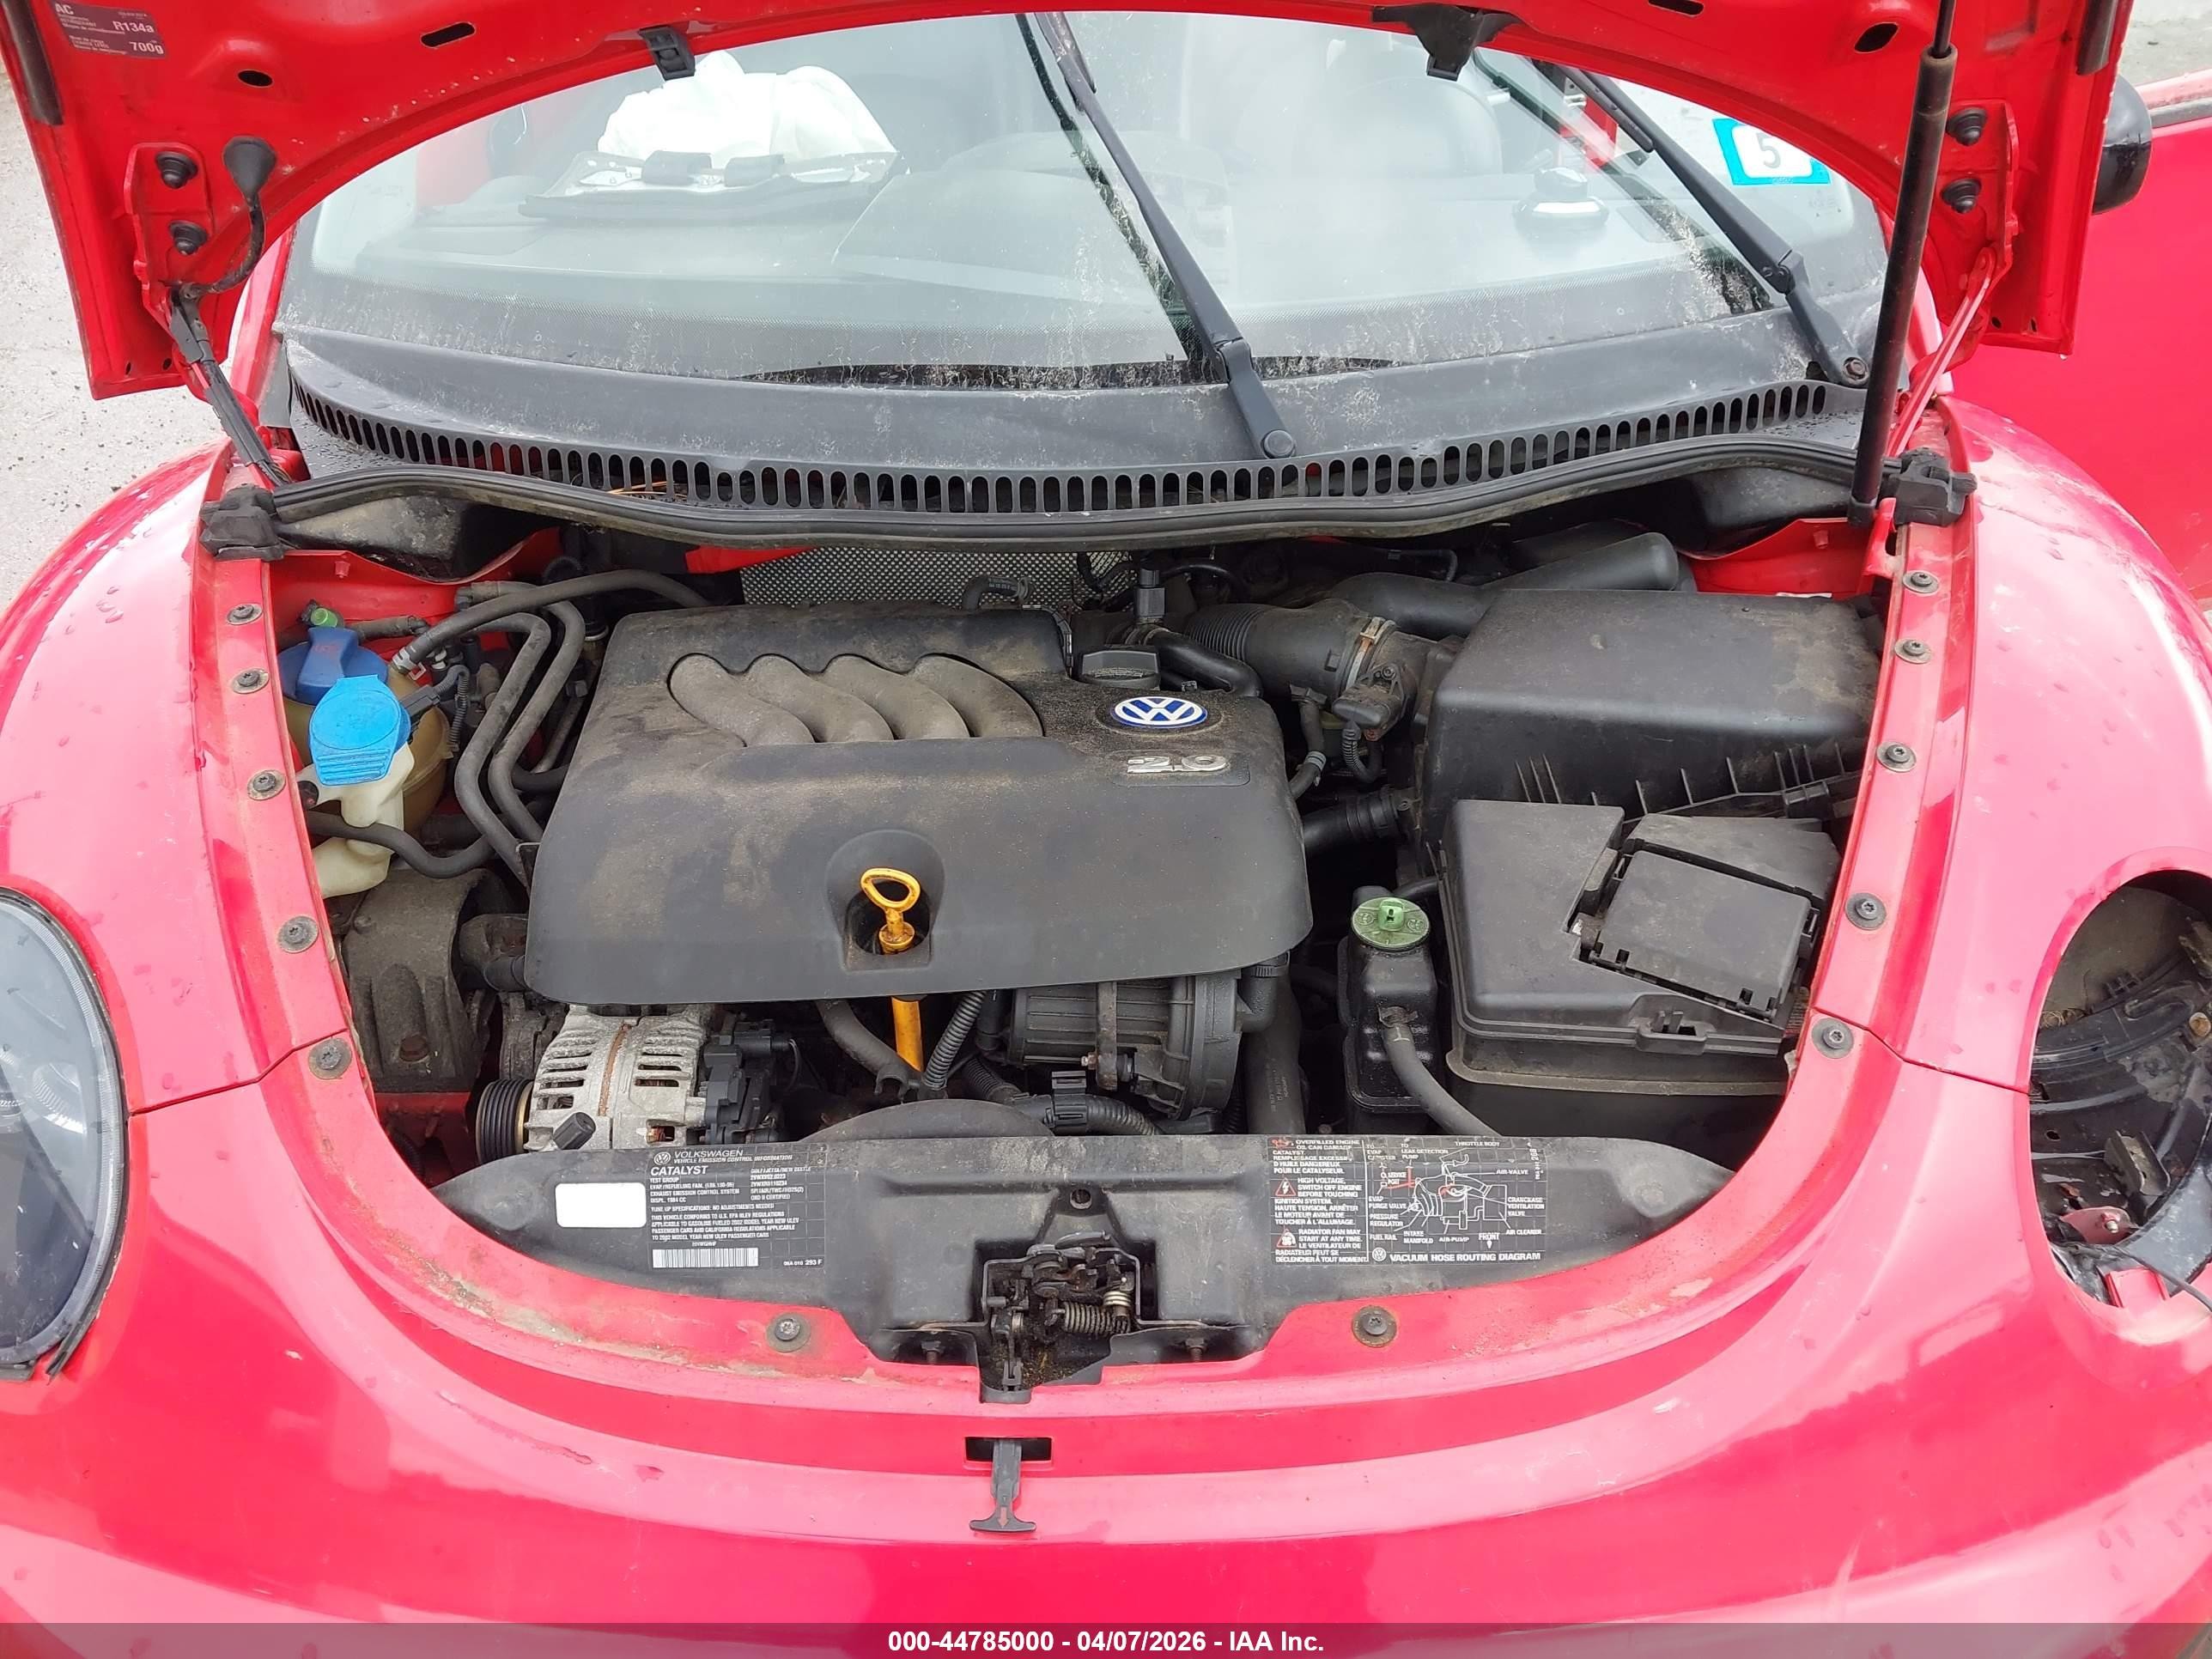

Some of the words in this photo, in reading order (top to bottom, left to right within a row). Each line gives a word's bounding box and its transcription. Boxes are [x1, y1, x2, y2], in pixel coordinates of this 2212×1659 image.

[55, 3, 75, 15] AC
[112, 21, 155, 33] R134a
[129, 41, 164, 54] 700g
[1756, 132, 1781, 169] 5
[1127, 756, 1228, 773] 2.0
[674, 1150, 744, 1158] VOLKSWAGEN
[651, 1165, 708, 1176] CATALYST
